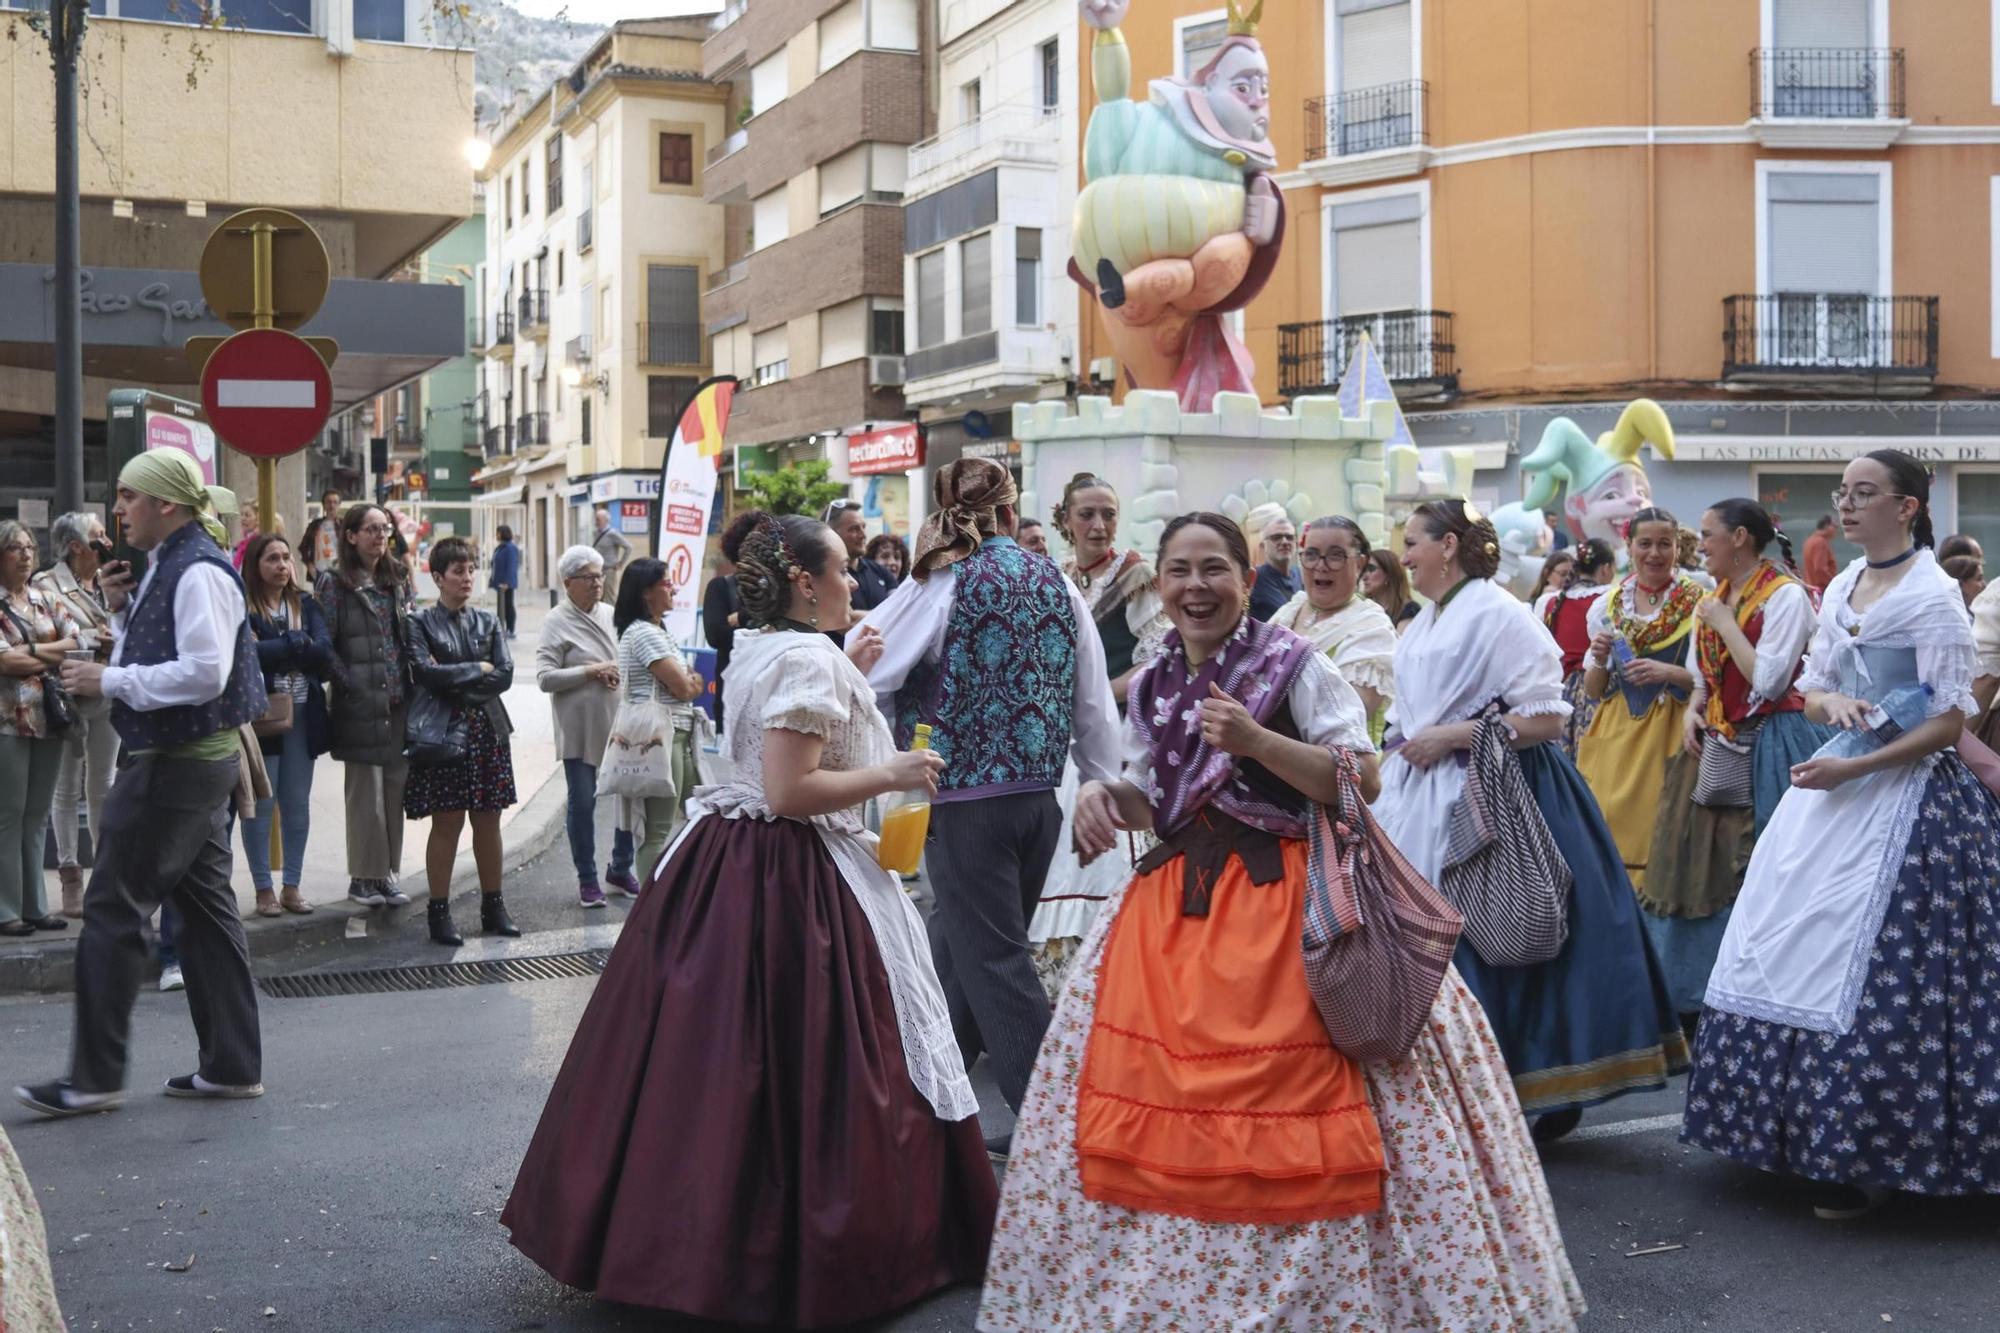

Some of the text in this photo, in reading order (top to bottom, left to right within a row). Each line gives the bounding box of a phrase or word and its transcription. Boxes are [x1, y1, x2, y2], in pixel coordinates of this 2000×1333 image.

[1699, 446, 1738, 459] LAS
[1749, 446, 1840, 459] DELICIAS
[1958, 446, 1986, 459] DE
